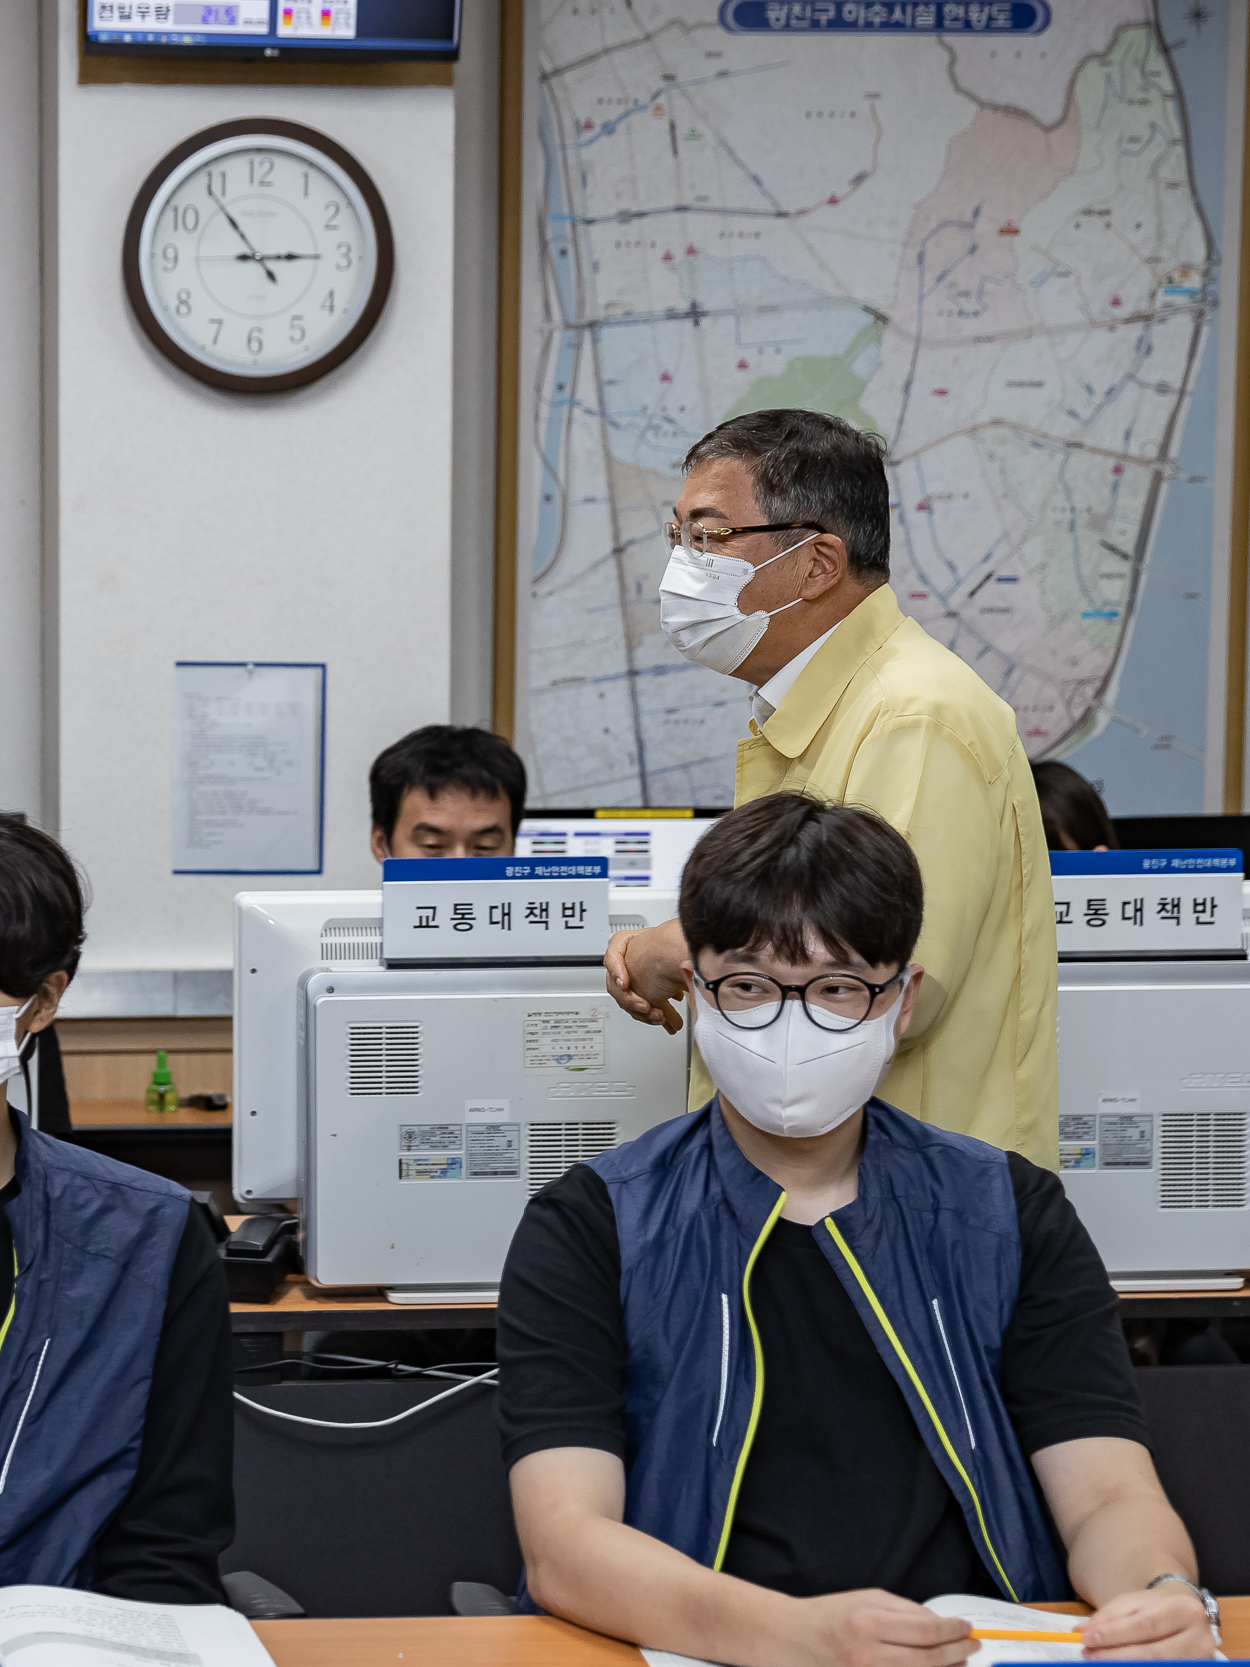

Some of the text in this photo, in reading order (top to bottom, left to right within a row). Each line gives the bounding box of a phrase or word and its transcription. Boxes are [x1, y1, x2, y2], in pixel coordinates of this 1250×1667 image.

[765, 2, 1013, 30] 광진구 하수시설 현황도
[206, 169, 227, 197] 11
[247, 156, 275, 187] 12
[301, 169, 310, 198] 1
[170, 203, 200, 234] 10
[323, 200, 341, 231] 2
[161, 242, 179, 273] 9
[334, 241, 353, 273] 3
[175, 287, 193, 318] 8
[320, 287, 336, 316] 4
[207, 317, 225, 347] 7
[246, 325, 264, 357] 6
[288, 314, 306, 345] 5
[505, 864, 602, 878] 광진구 재난안전대책본부
[412, 900, 588, 932] 교통대책반
[1054, 896, 1219, 928] 교통대책반
